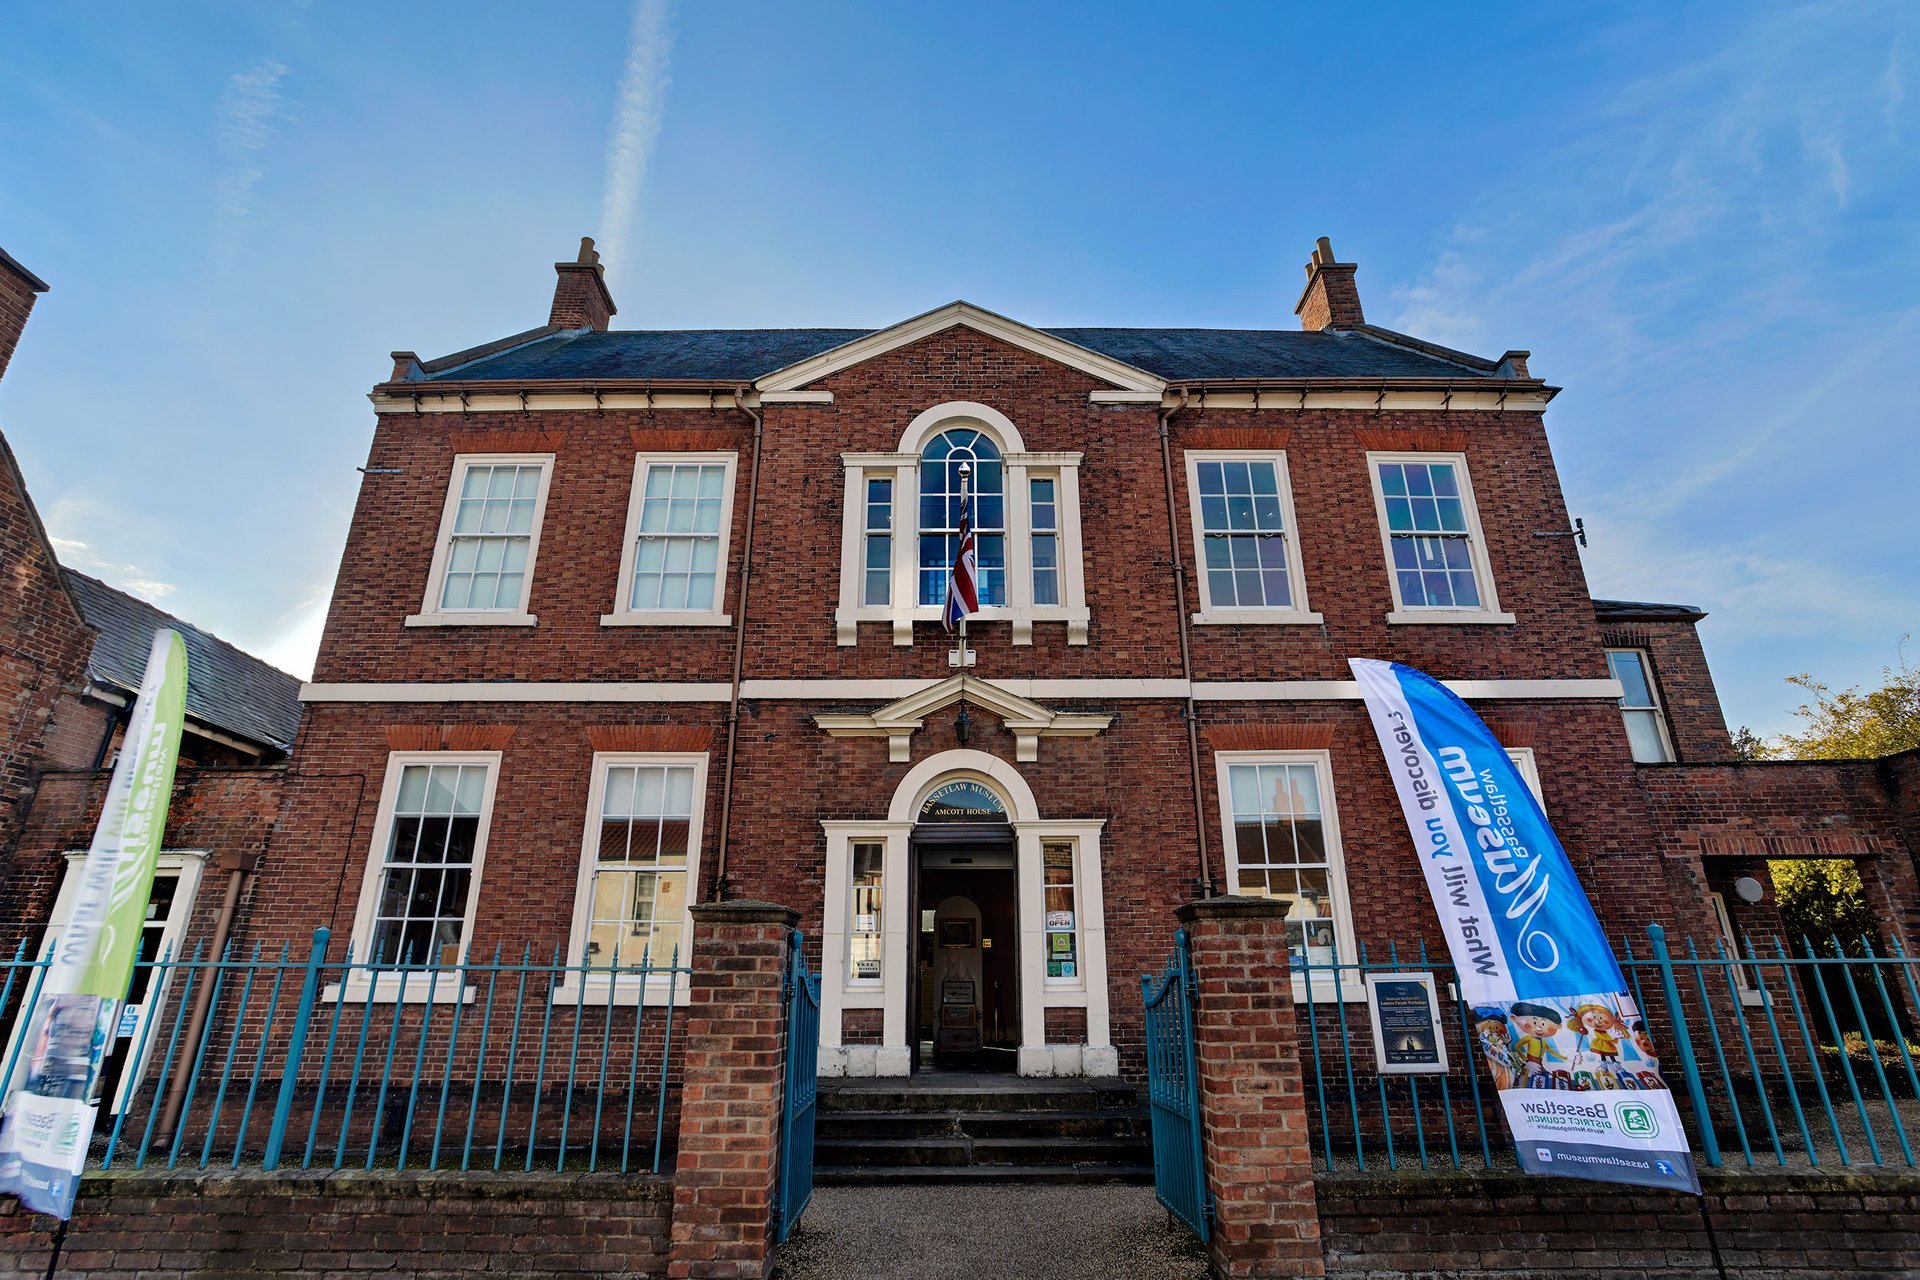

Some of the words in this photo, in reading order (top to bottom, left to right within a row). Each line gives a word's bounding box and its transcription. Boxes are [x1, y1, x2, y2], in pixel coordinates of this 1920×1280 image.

[921, 783, 968, 814] BASSETLAW
[969, 784, 1006, 813] MUSEUM
[1049, 919, 1070, 927] OPEN
